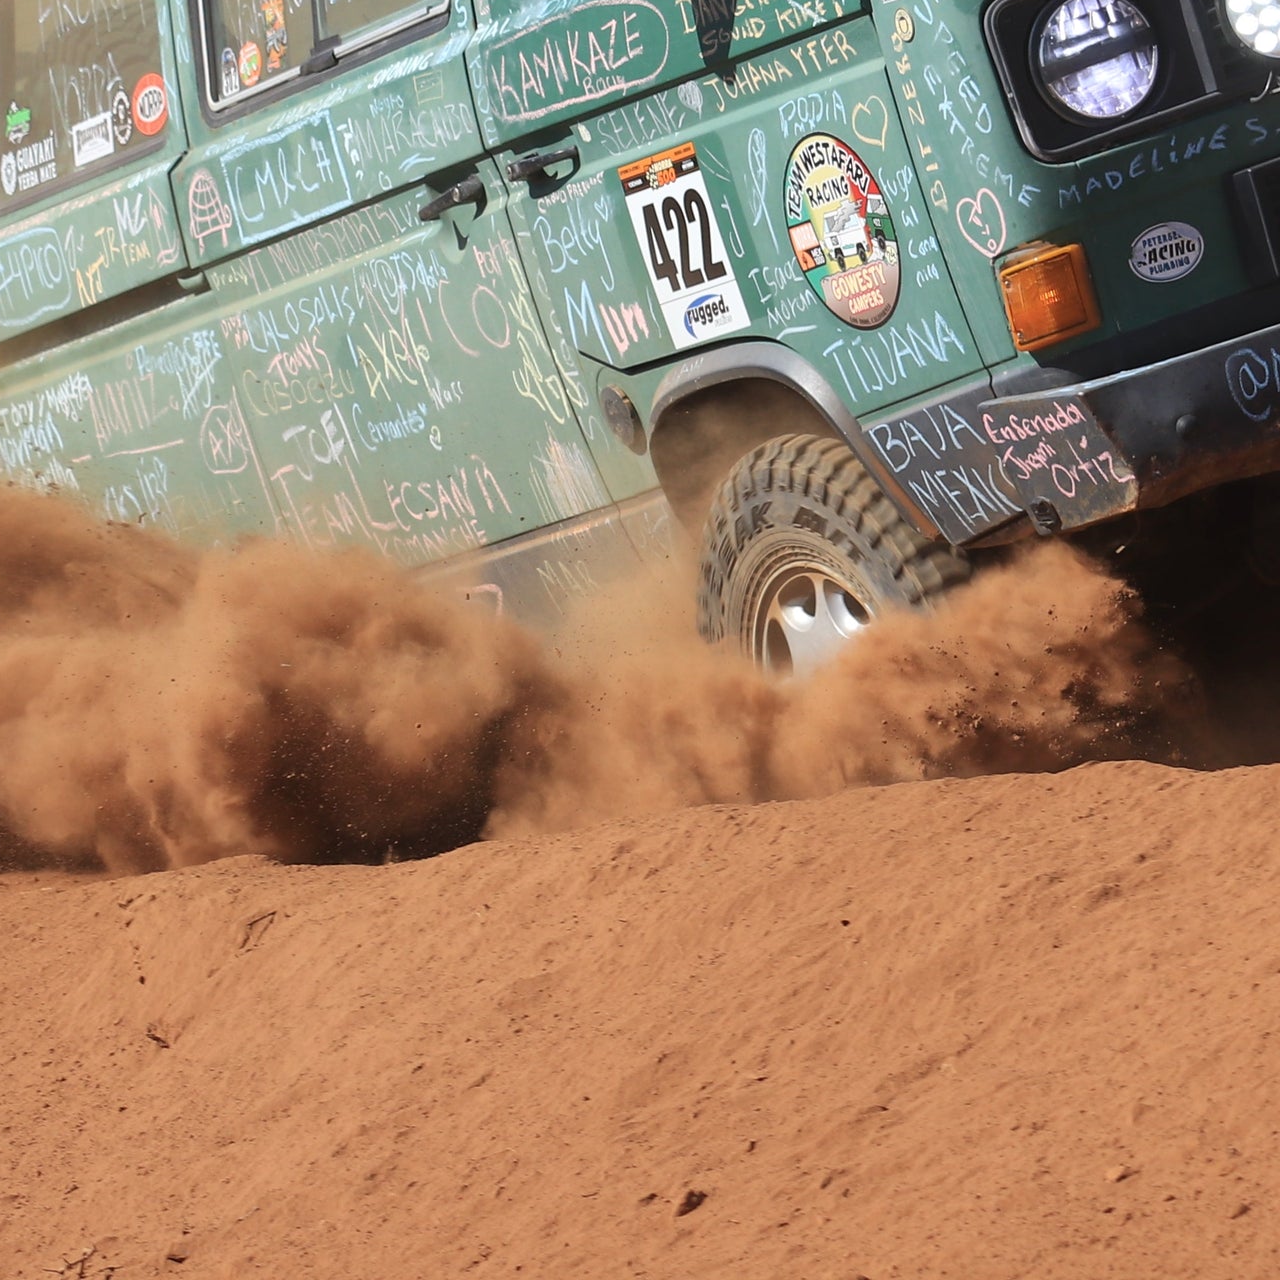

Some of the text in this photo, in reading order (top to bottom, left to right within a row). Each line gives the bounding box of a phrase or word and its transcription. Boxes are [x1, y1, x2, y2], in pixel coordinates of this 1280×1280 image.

[492, 11, 643, 118] KAMIKAZE
[597, 91, 685, 157] SELENE
[657, 169, 676, 188] 500
[787, 161, 806, 220] TEAM
[799, 141, 870, 196] WESTAFARI
[806, 175, 849, 208] RACING
[642, 188, 727, 293] 422
[831, 263, 887, 301] GOWESTY
[1149, 256, 1191, 275] PLUMBING
[848, 287, 884, 315] CAMPERS
[869, 404, 987, 473] BAJA
[982, 402, 1086, 444] Ensenada
